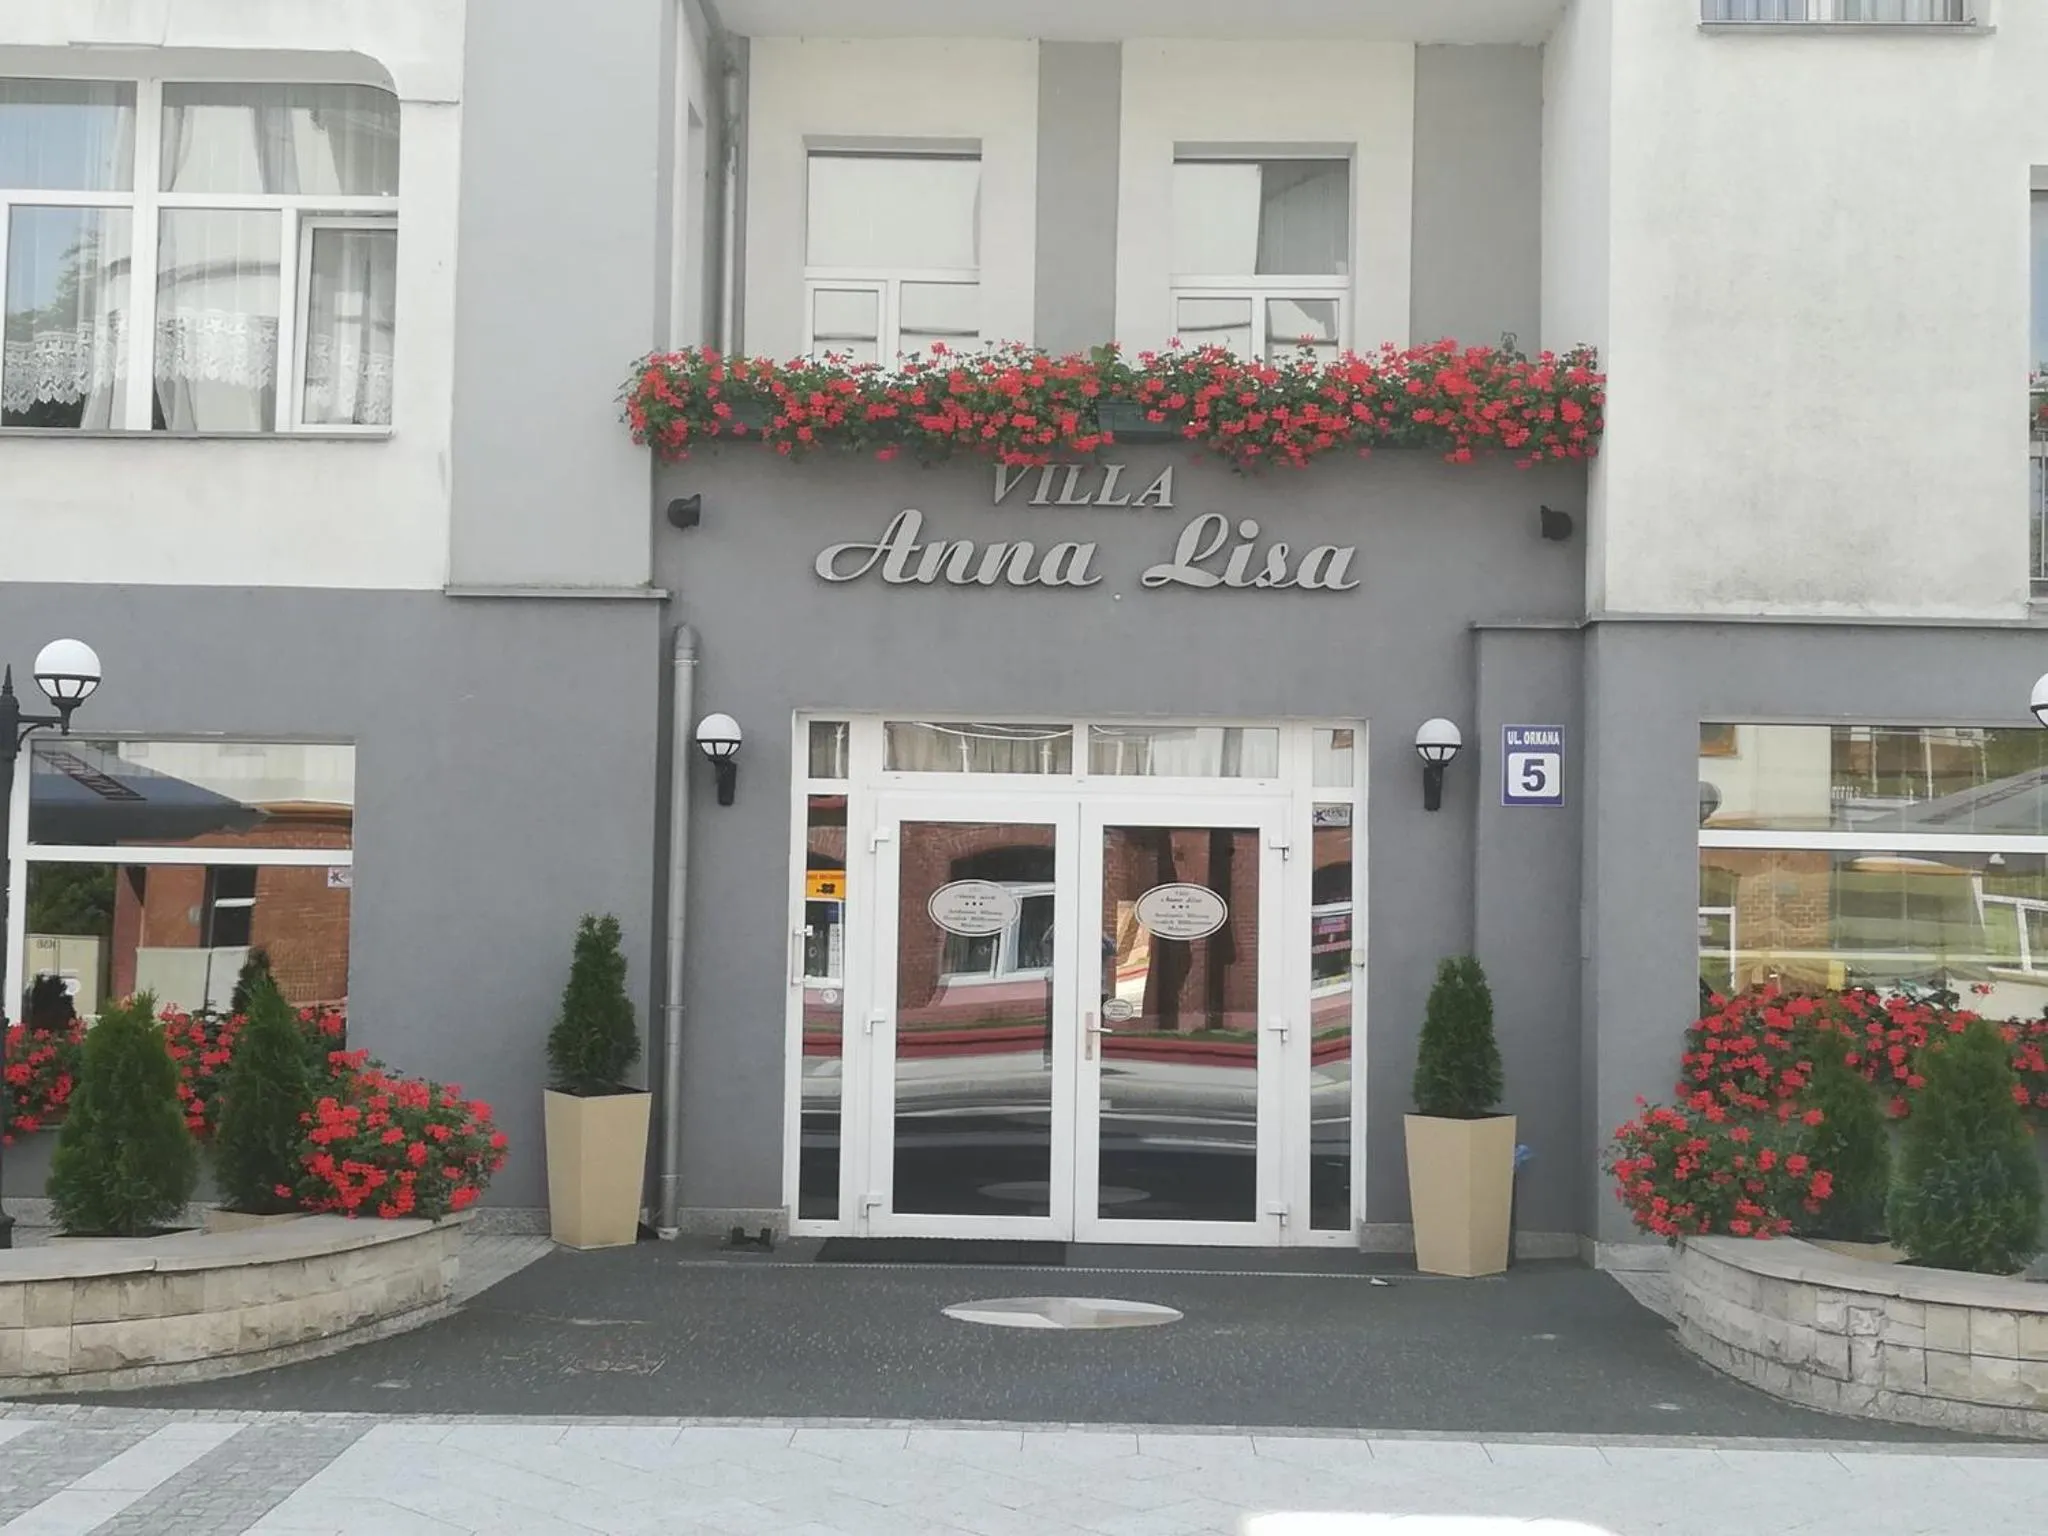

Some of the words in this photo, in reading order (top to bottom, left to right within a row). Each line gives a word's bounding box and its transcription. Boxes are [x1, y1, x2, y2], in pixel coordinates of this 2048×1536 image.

[993, 464, 1175, 507] VILLA
[814, 508, 1102, 586] Anna
[1141, 512, 1360, 590] Lisa
[1507, 731, 1523, 745] UL.
[1523, 731, 1560, 745] ORKANA
[1521, 758, 1546, 792] 5
